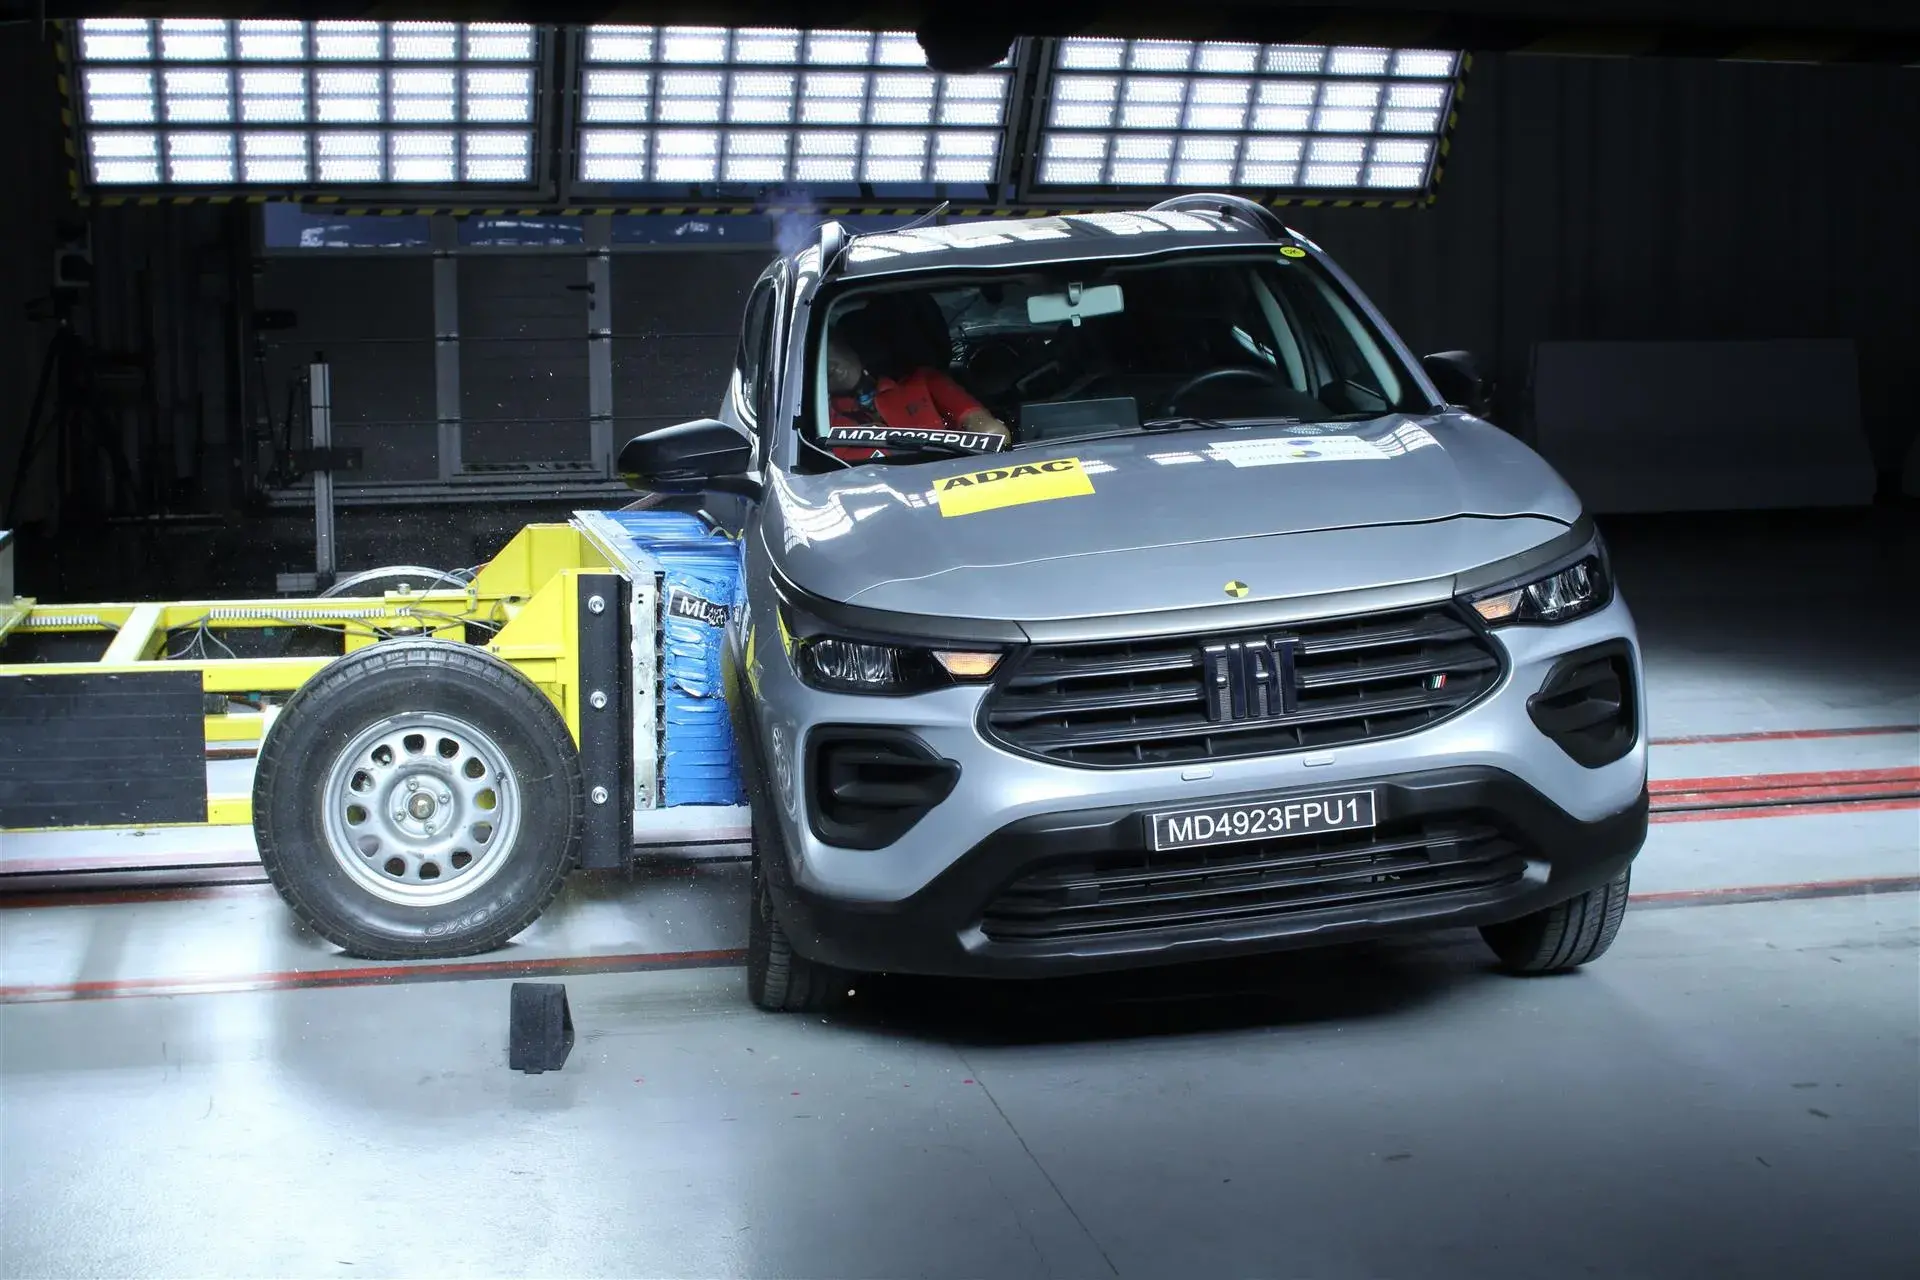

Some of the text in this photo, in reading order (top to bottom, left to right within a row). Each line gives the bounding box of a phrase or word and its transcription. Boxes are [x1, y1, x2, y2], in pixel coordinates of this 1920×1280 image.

[838, 429, 990, 450] MD4FPU1
[943, 460, 1075, 491] ADAC
[1203, 635, 1302, 722] FIAT
[1168, 798, 1360, 843] MD4923FPU1
